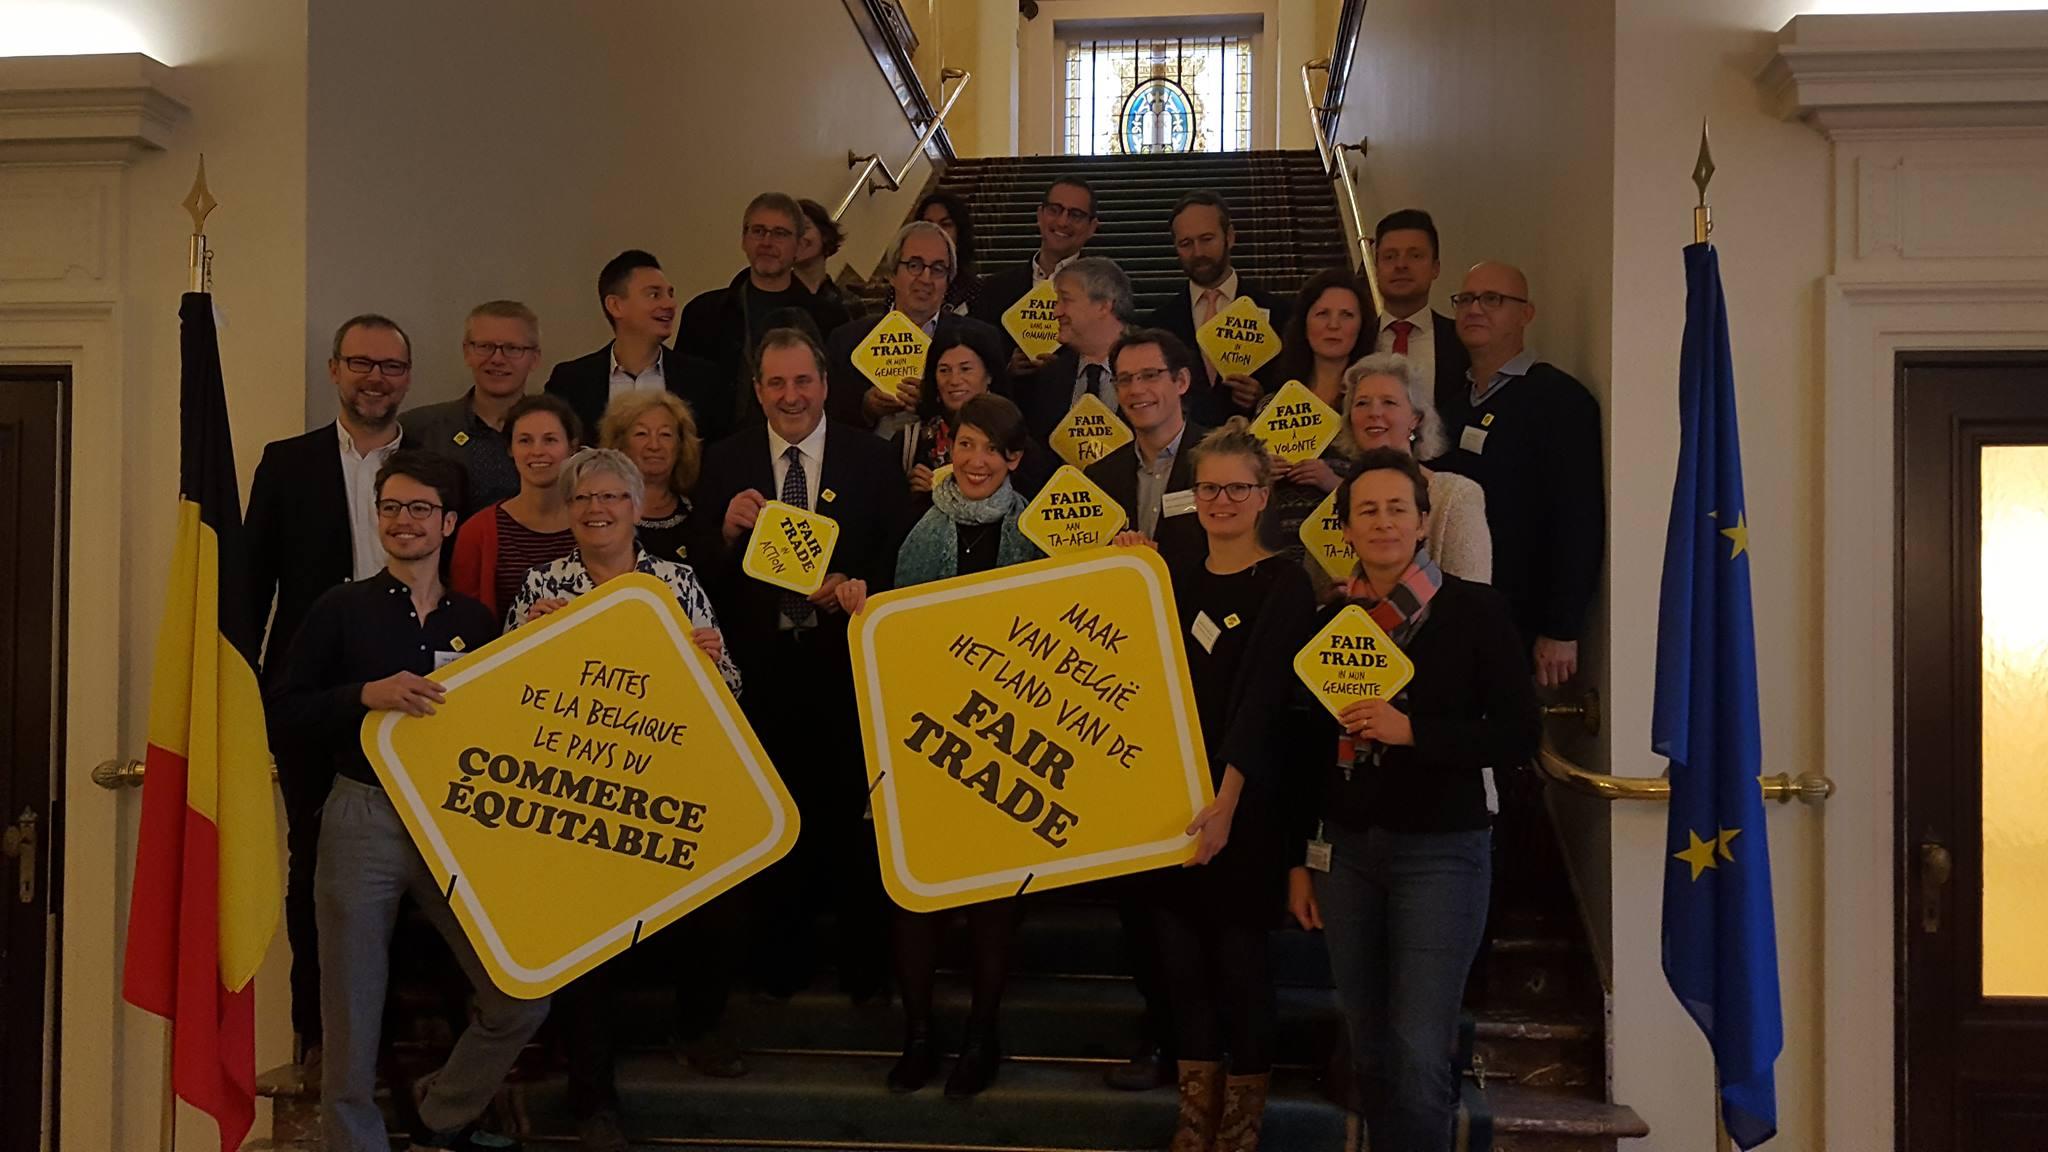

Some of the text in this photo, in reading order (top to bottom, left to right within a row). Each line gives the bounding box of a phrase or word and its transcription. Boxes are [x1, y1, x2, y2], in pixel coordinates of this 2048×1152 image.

[1225, 316, 1258, 331] FAIR
[879, 332, 914, 344] FAIR
[1216, 327, 1265, 344] TRADE
[870, 344, 923, 357] TRADE
[1220, 351, 1252, 366] ACTION
[874, 365, 919, 377] GEMEENTE
[1276, 402, 1312, 417] FAIR
[1075, 415, 1105, 426] FAIR
[1267, 414, 1322, 431] TRADE
[1068, 426, 1113, 438] TRADE
[1078, 440, 1104, 460] FAN
[1274, 435, 1317, 454] VOLONTÉ
[1050, 491, 1091, 505] FAIR
[1041, 505, 1104, 521] TRADE
[1066, 522, 1080, 531] AAN
[780, 516, 815, 573] TRADE
[797, 519, 822, 558] FAIR
[1048, 531, 1099, 546] TA-AFEL!
[760, 540, 786, 574] ACTION
[1059, 602, 1128, 654] MAAK
[1330, 635, 1376, 650] FAIR
[1007, 616, 1141, 712] VAN BELGIË
[1319, 651, 1388, 668] TRADE
[580, 660, 652, 699] FAITES
[1338, 670, 1346, 678] IN
[1322, 680, 1382, 697] GEMEENTE
[949, 634, 1143, 769] HET LAND VAN DE
[521, 684, 688, 746] DE LA BELGIQUE
[952, 689, 1075, 791] FAIR
[533, 726, 653, 775] LE PAYS DU
[903, 711, 1079, 849] TRADE
[458, 746, 708, 833] COMMERCE
[441, 775, 699, 872] ÉQUITABLE
